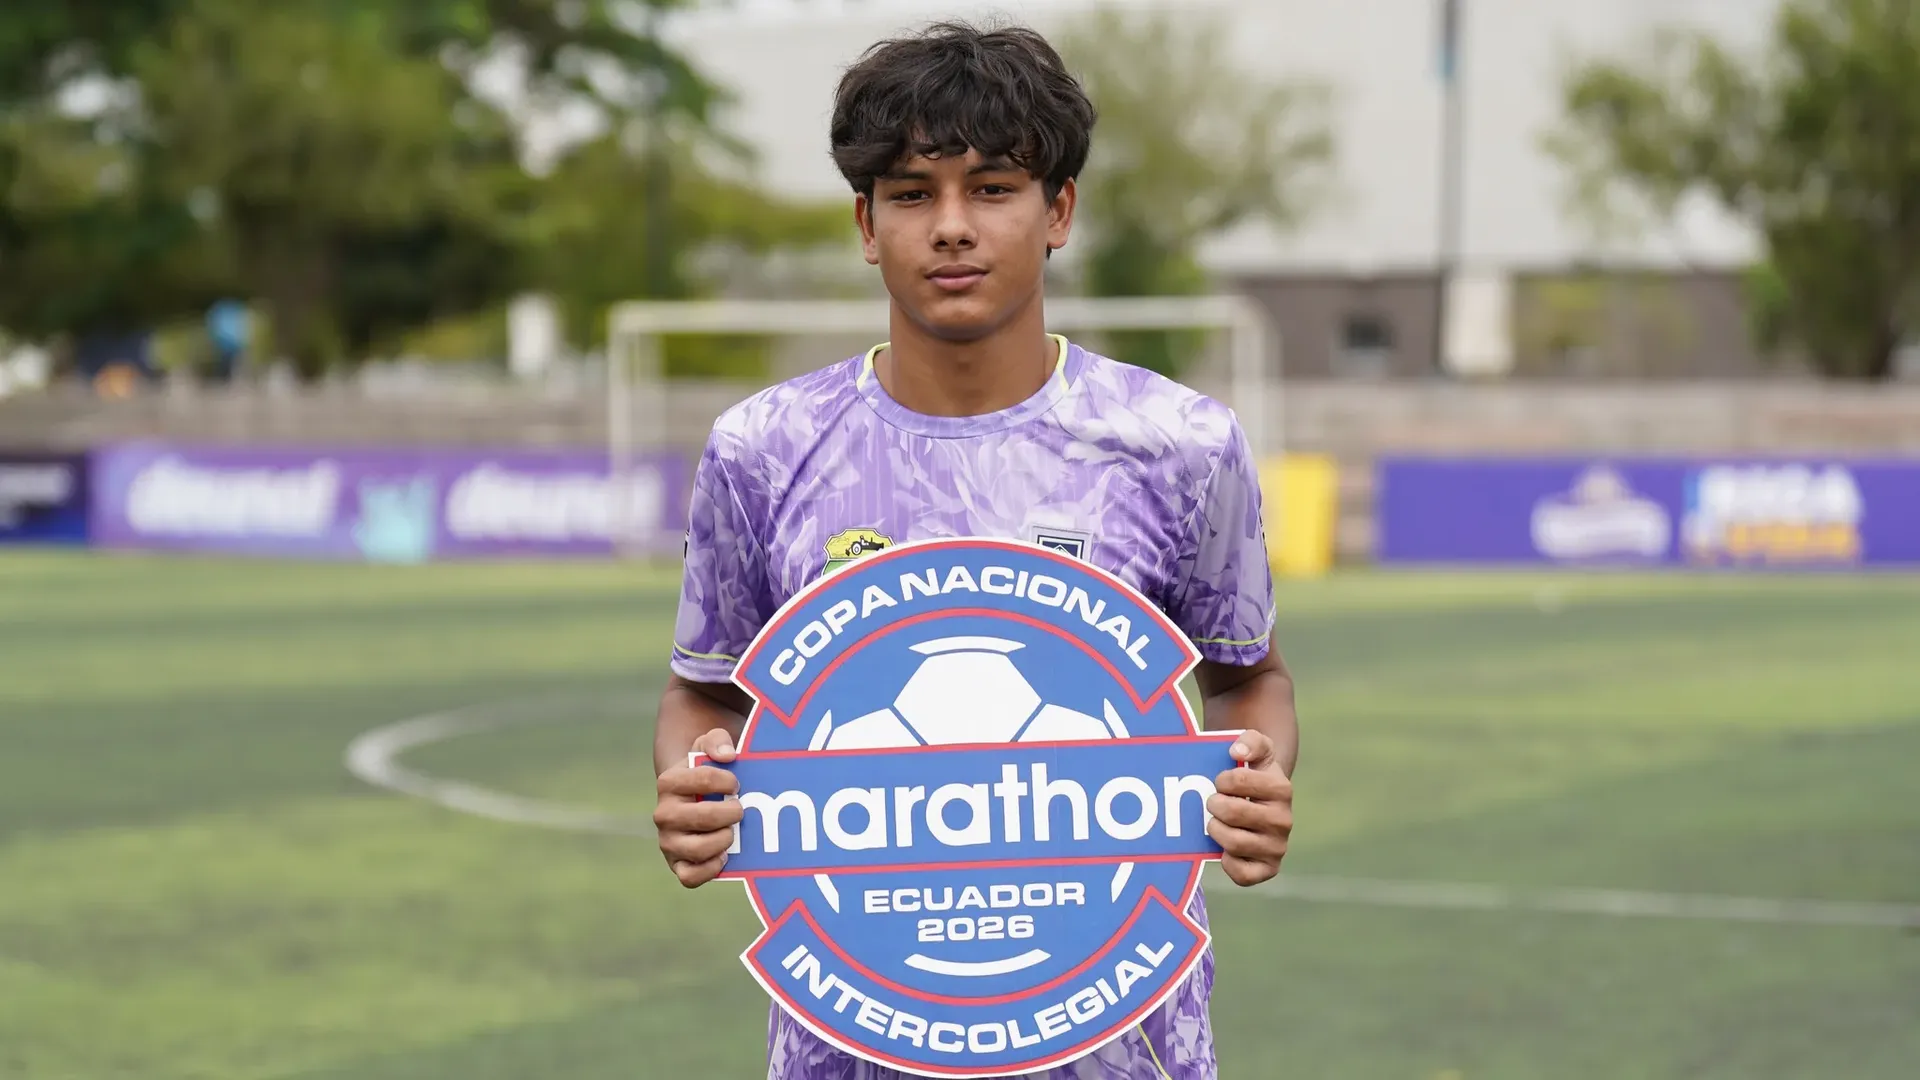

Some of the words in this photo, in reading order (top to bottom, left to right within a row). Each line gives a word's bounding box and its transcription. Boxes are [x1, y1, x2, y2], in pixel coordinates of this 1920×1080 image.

[769, 585, 898, 687] COPA
[900, 566, 1149, 671] NACIONAL
[724, 763, 1218, 854] marathon
[863, 882, 1086, 914] ECUADOR
[917, 915, 1035, 943] 2026
[781, 941, 1174, 1054] INTERCOLEGIAL
